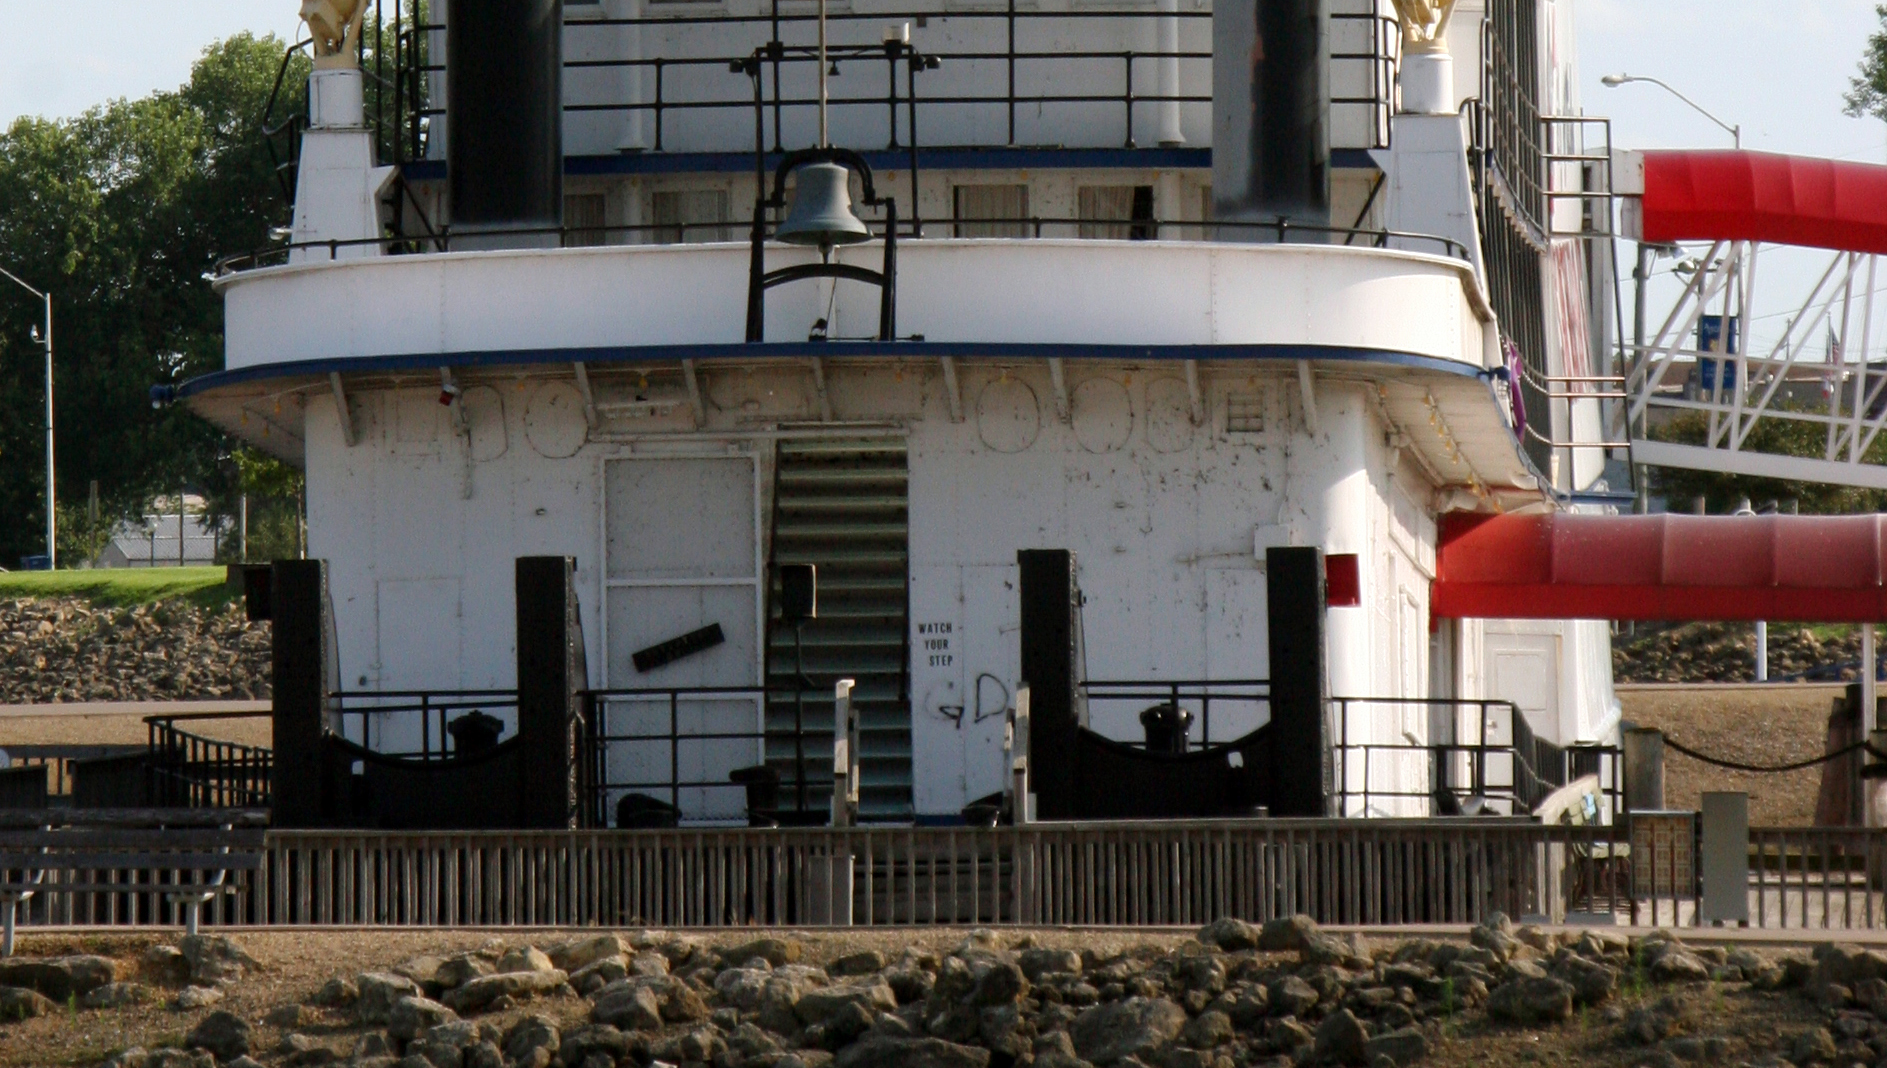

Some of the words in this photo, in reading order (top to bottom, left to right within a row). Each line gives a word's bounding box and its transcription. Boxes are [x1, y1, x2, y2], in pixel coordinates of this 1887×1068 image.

[918, 622, 953, 634] WATCH
[924, 638, 949, 651] YOUR
[929, 654, 953, 667] STEP
